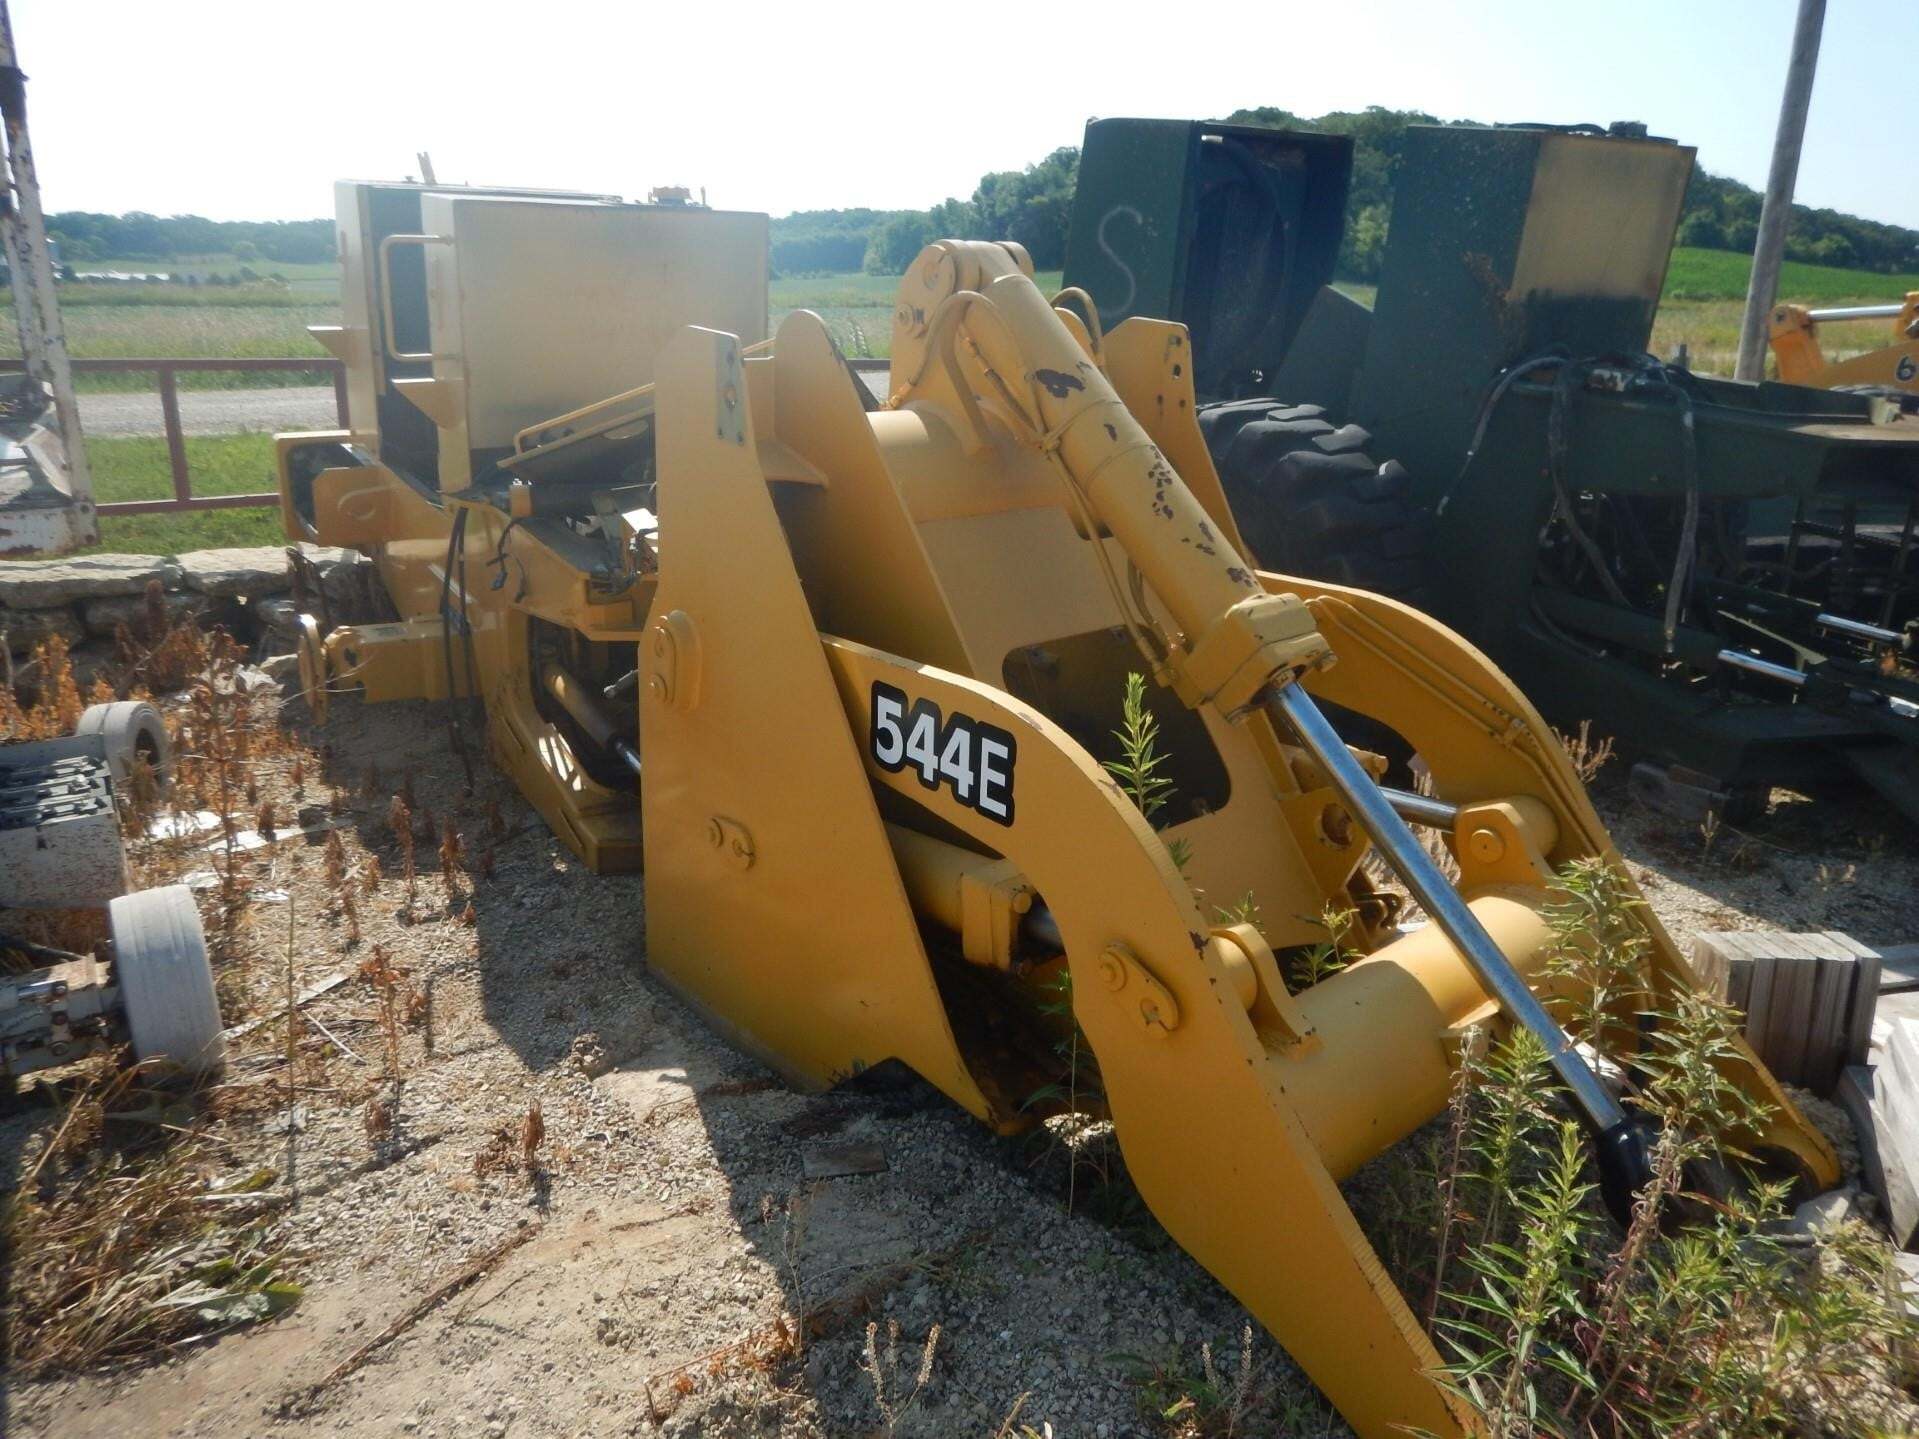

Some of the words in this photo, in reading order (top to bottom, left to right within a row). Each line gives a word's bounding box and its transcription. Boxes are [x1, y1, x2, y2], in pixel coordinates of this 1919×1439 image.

[1097, 204, 1144, 318] S
[1895, 355, 1917, 382] 6
[873, 691, 1011, 821] 544E
